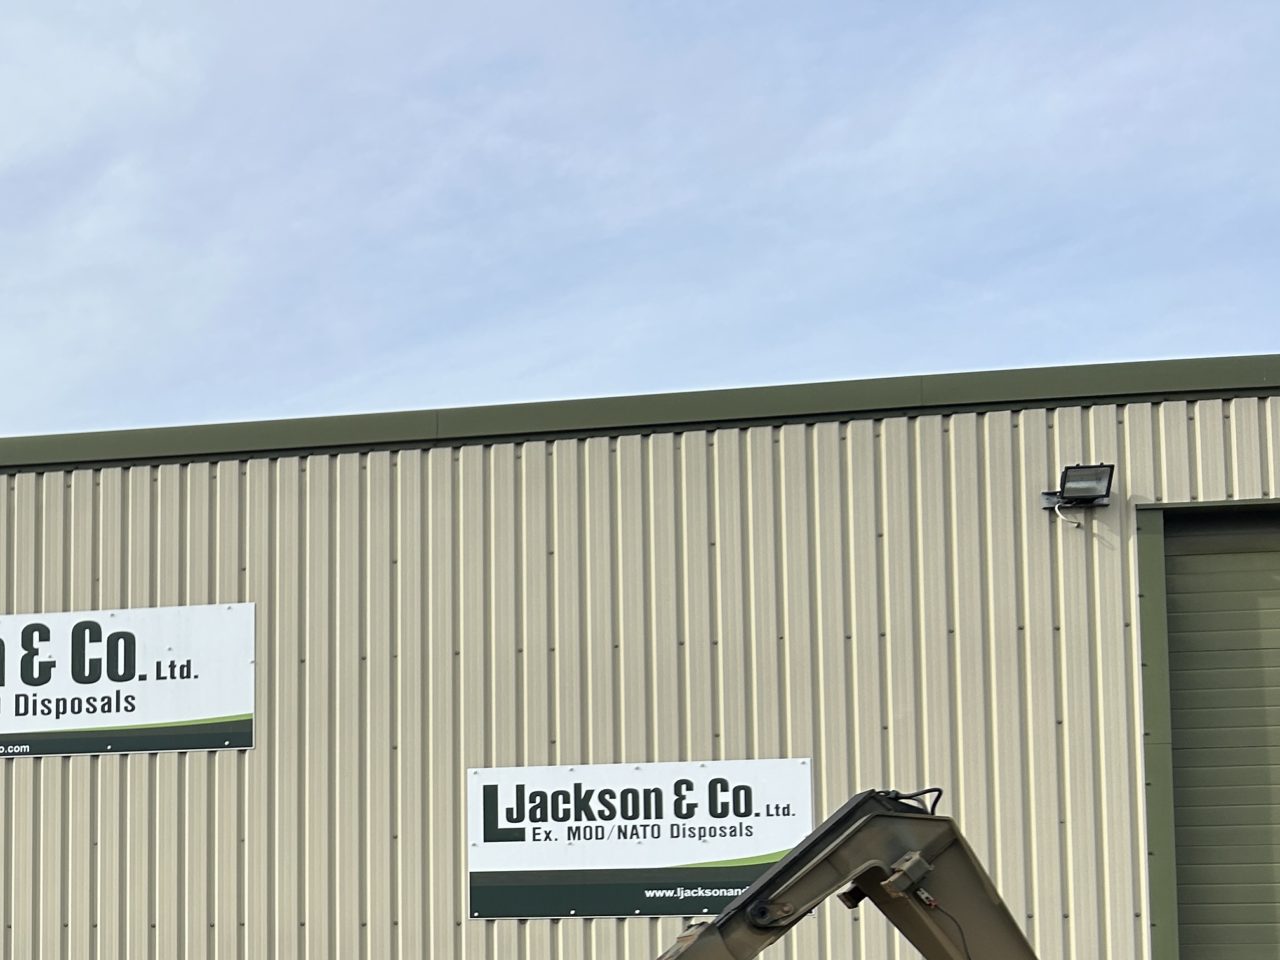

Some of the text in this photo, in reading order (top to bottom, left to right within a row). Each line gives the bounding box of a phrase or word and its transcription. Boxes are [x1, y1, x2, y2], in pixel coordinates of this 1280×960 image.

[20, 622, 57, 688] &
[71, 620, 147, 686] Co.
[155, 658, 200, 681] Ltd.
[14, 690, 136, 720] Disposals
[673, 779, 698, 819] &
[708, 778, 761, 819] Co.
[766, 803, 797, 818] Ltd.
[532, 822, 754, 842] Ex. MOD/NATO Disposals
